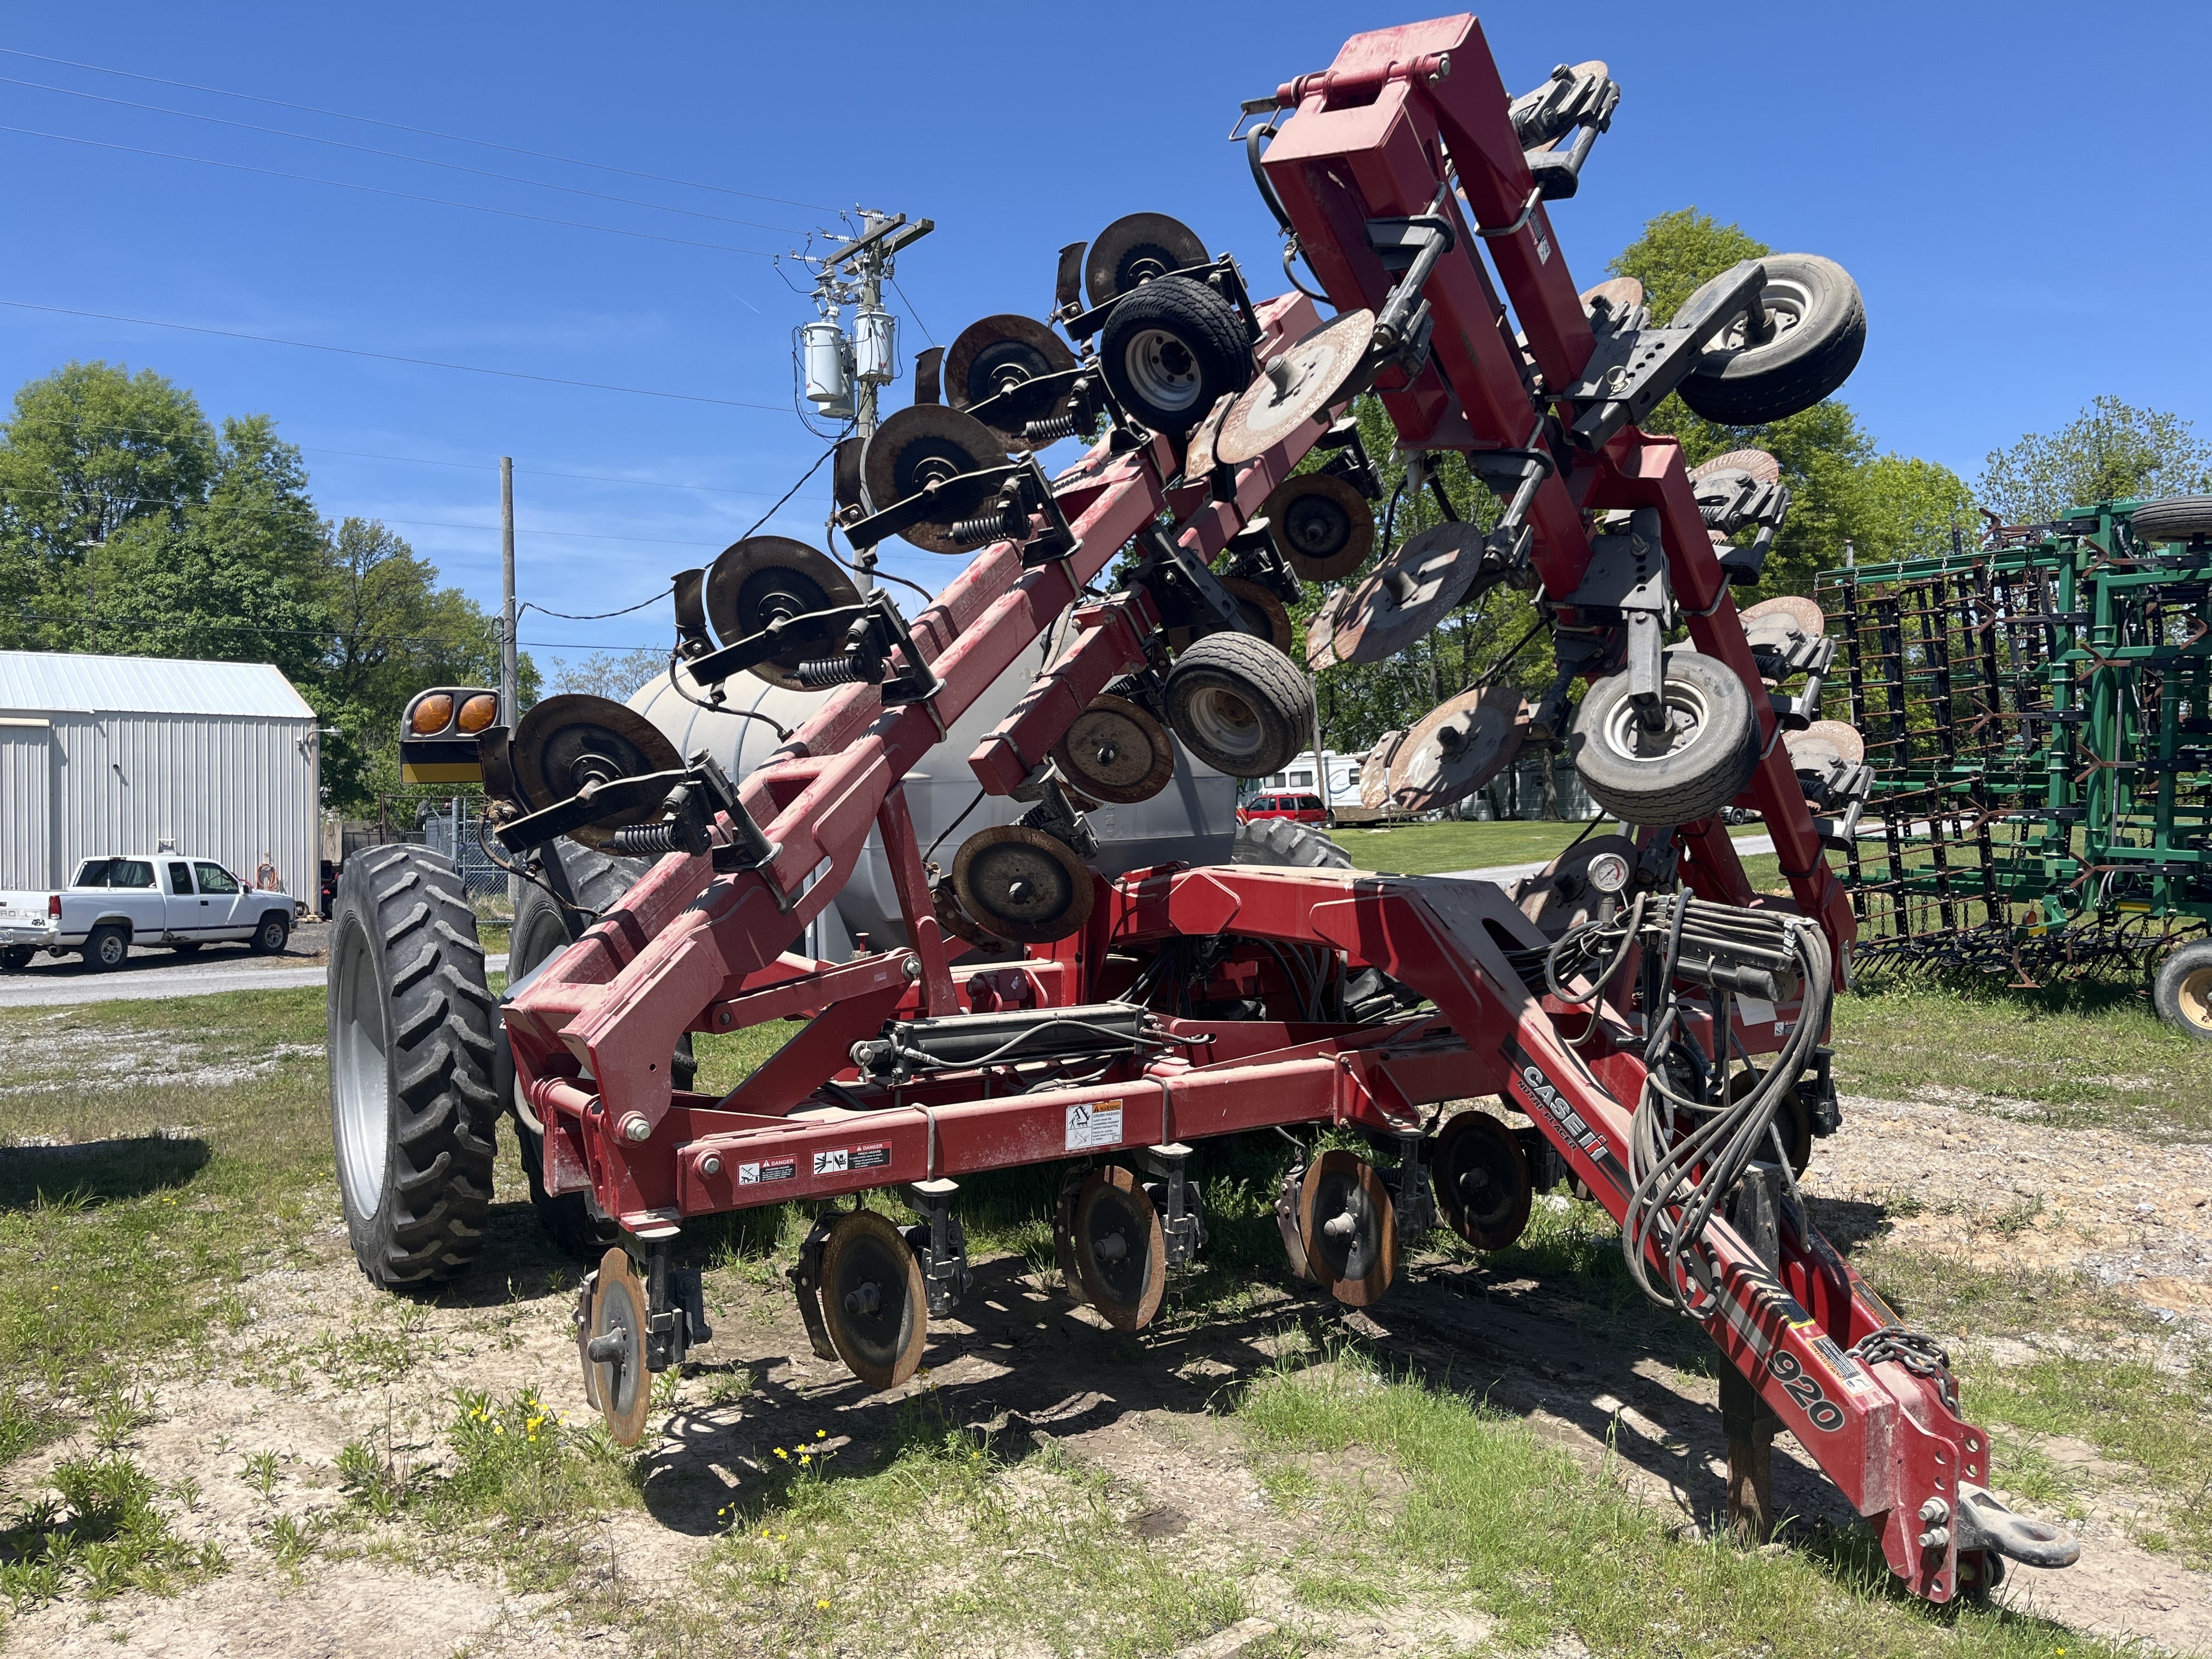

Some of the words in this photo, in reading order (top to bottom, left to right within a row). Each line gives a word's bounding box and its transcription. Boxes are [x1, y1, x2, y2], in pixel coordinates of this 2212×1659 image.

[1516, 1081, 1577, 1151] NUTRI-PLACER
[1766, 1350, 1845, 1432] 920
[1808, 1344, 1836, 1374] WARNING
